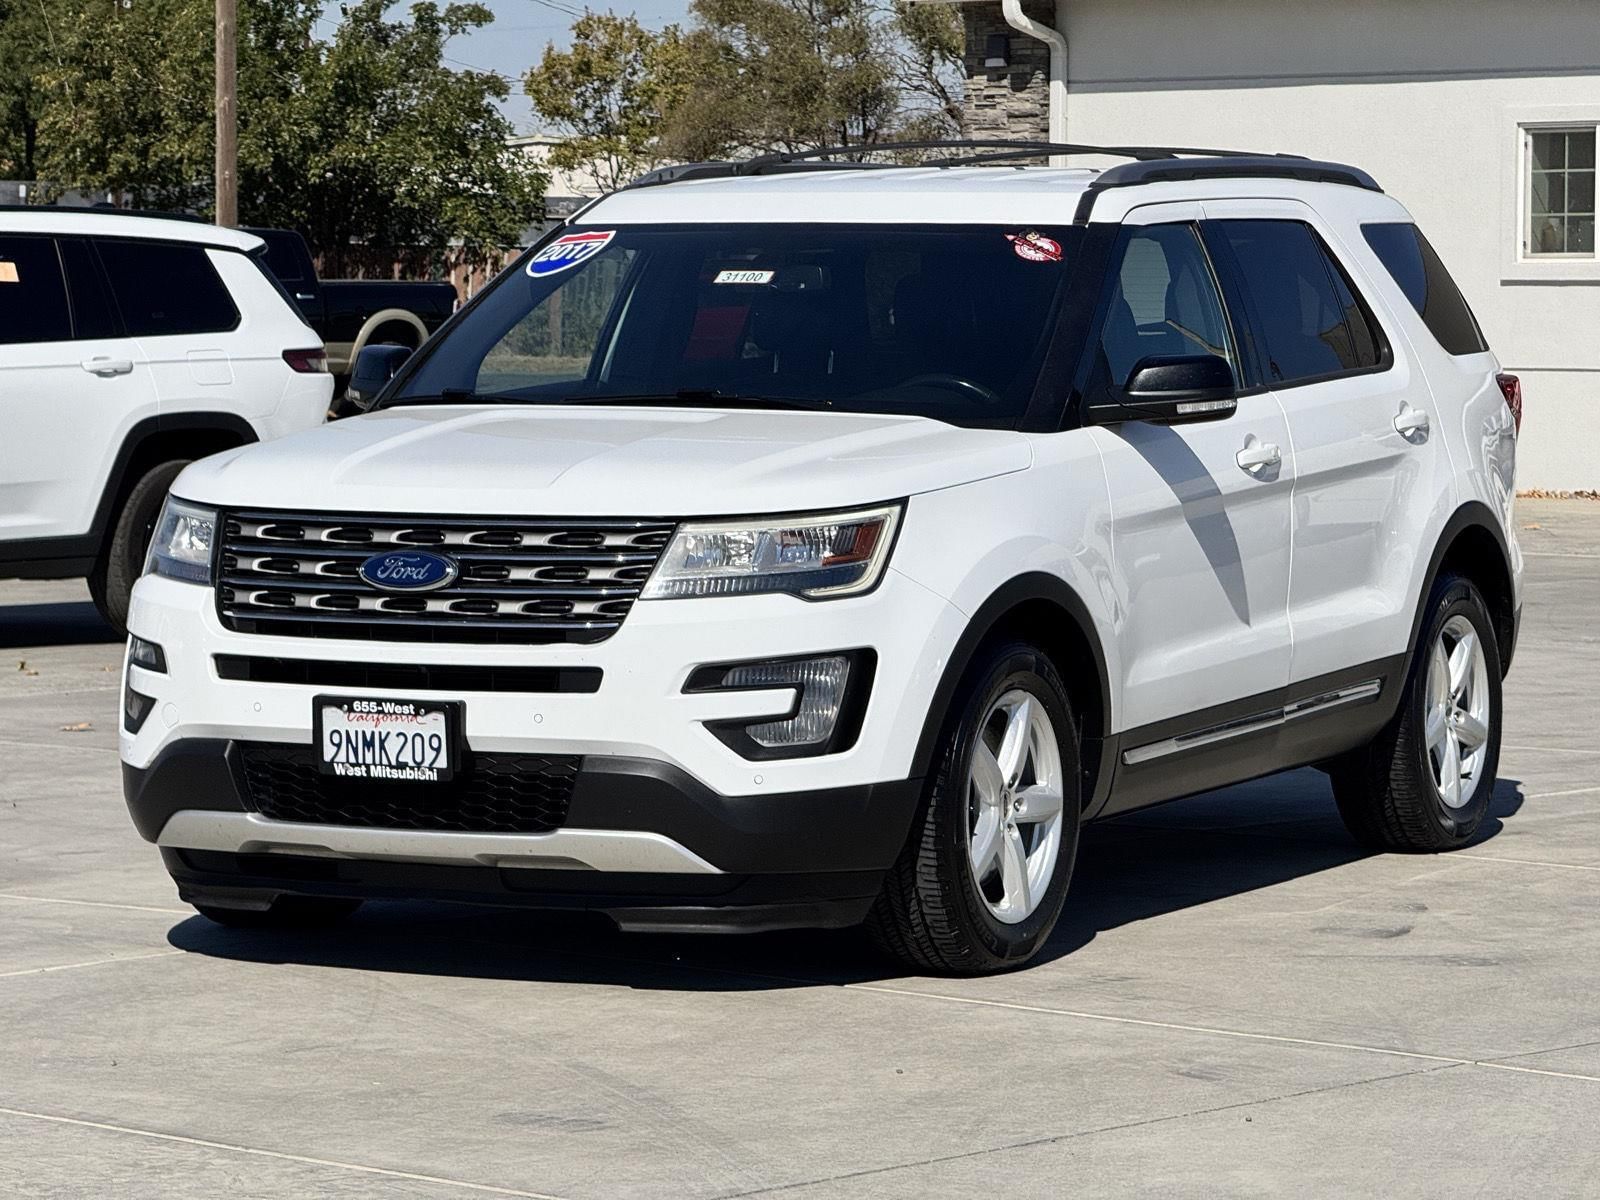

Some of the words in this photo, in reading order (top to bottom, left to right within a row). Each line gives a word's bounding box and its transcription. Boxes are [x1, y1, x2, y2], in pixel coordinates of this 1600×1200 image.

[534, 242, 603, 263] 2017
[721, 272, 764, 282] 31100
[377, 556, 432, 579] Ford
[353, 701, 415, 715] 655-West
[329, 729, 442, 767] 9NMK209
[333, 762, 367, 777] West
[370, 764, 438, 781] Mitsubishi
